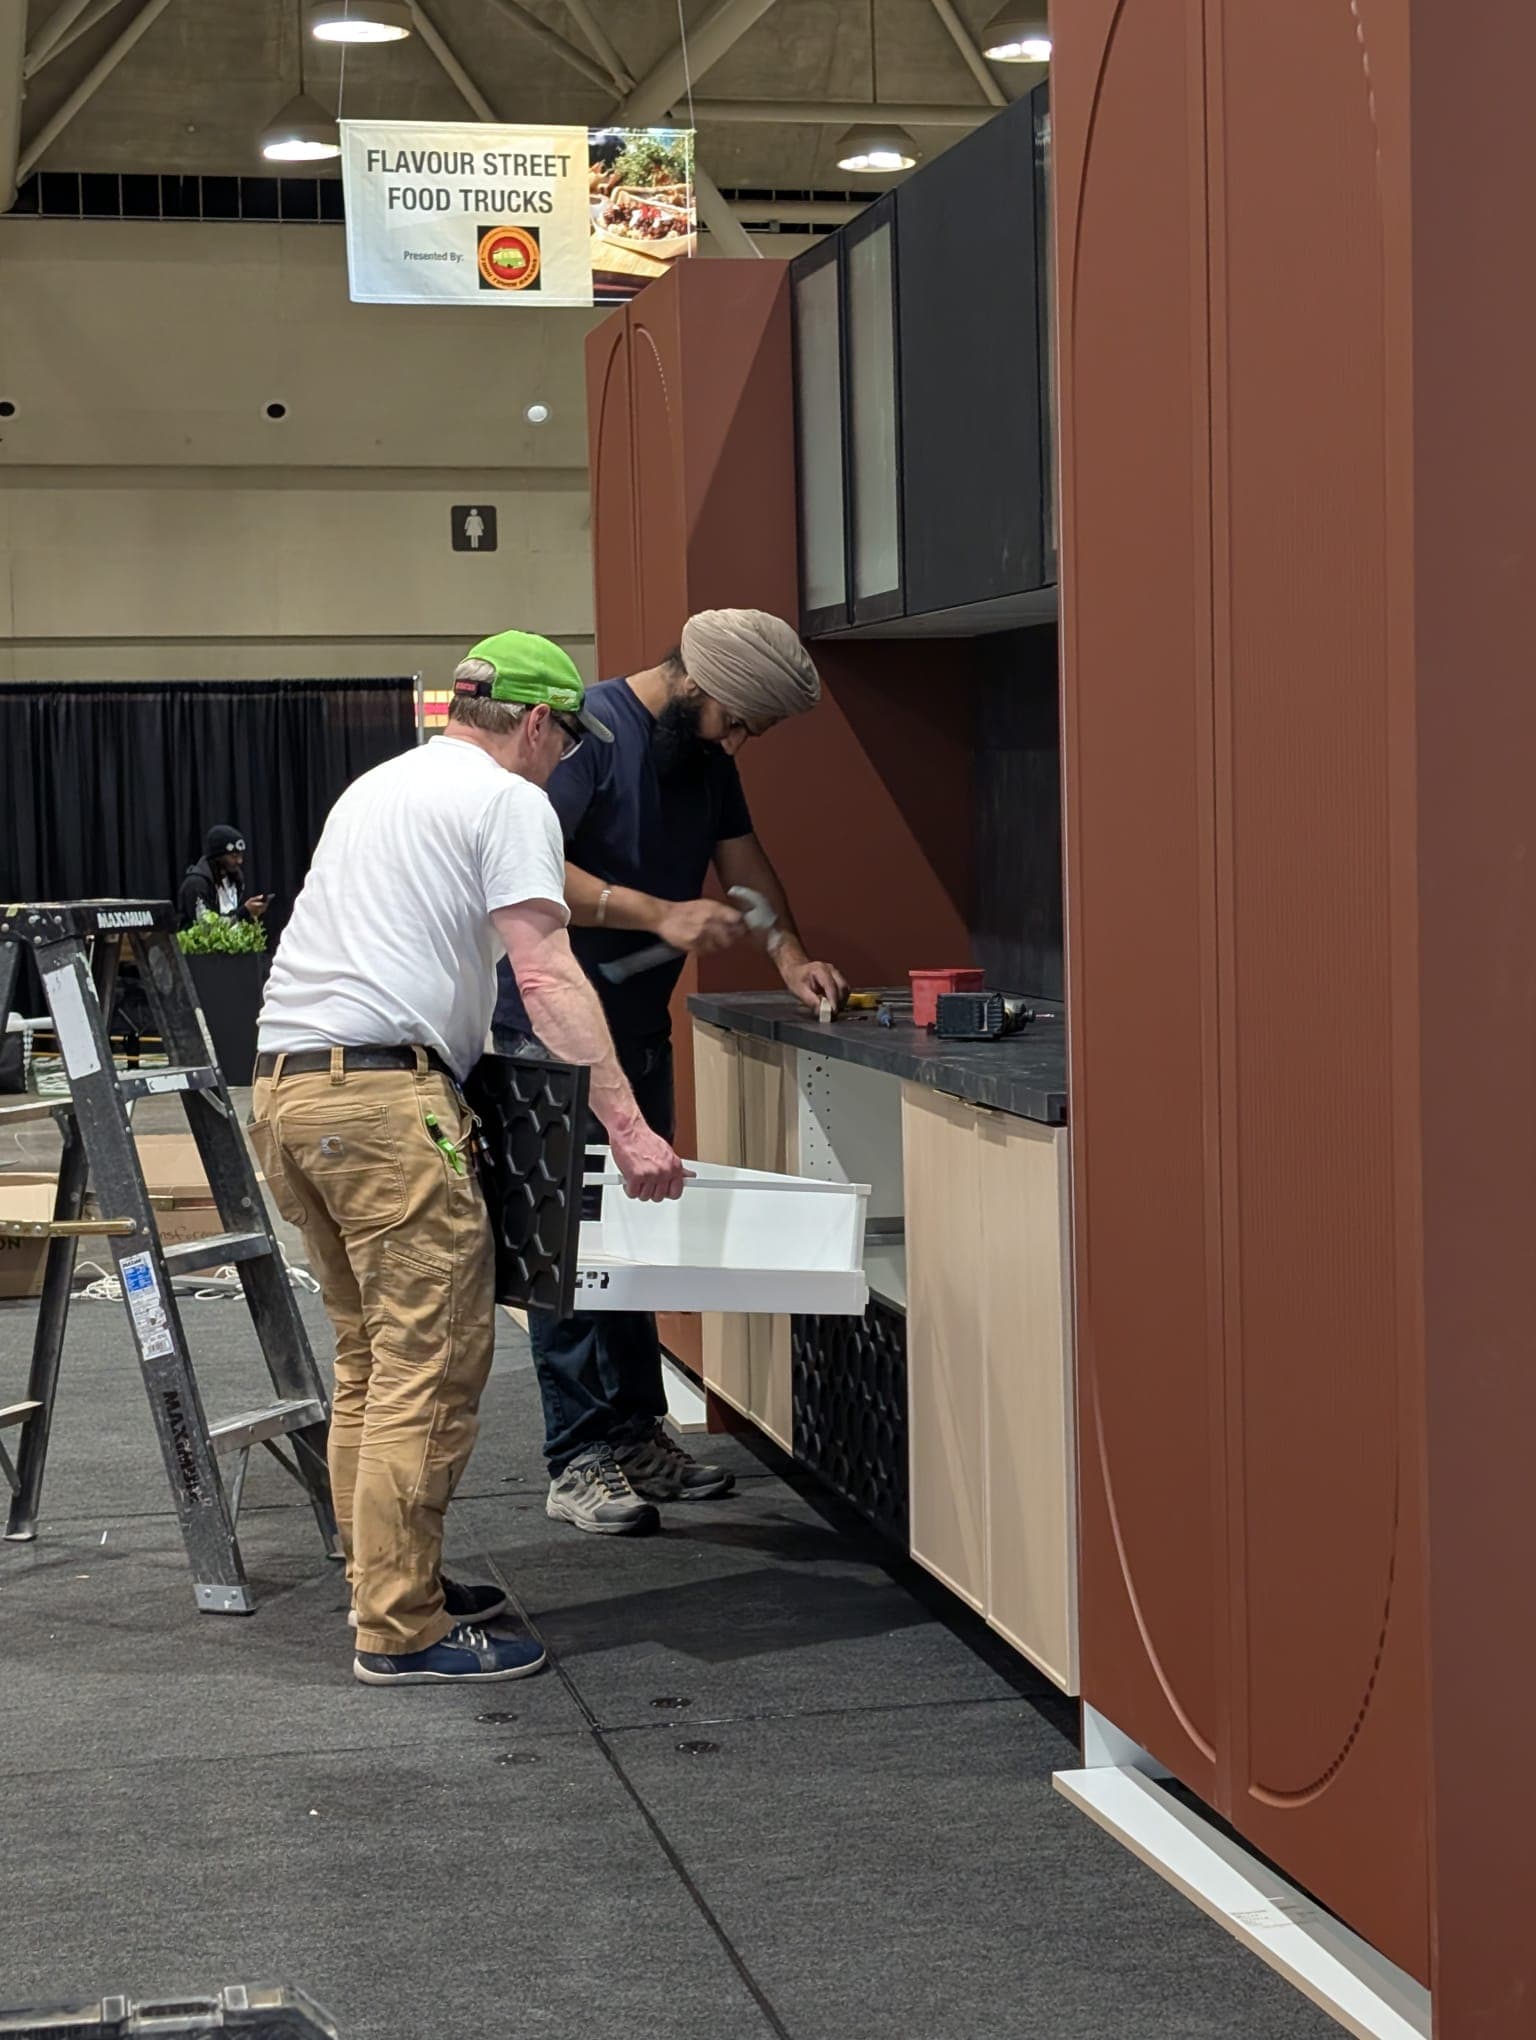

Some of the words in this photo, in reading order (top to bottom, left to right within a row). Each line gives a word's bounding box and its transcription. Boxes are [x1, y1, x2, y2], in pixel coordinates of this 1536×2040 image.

[367, 149, 475, 175] FLAVOUR
[483, 152, 571, 177] STREET
[388, 187, 450, 211] FOOD
[459, 189, 553, 214] TRUCKS
[403, 250, 448, 261] Presented
[450, 251, 464, 263] By:
